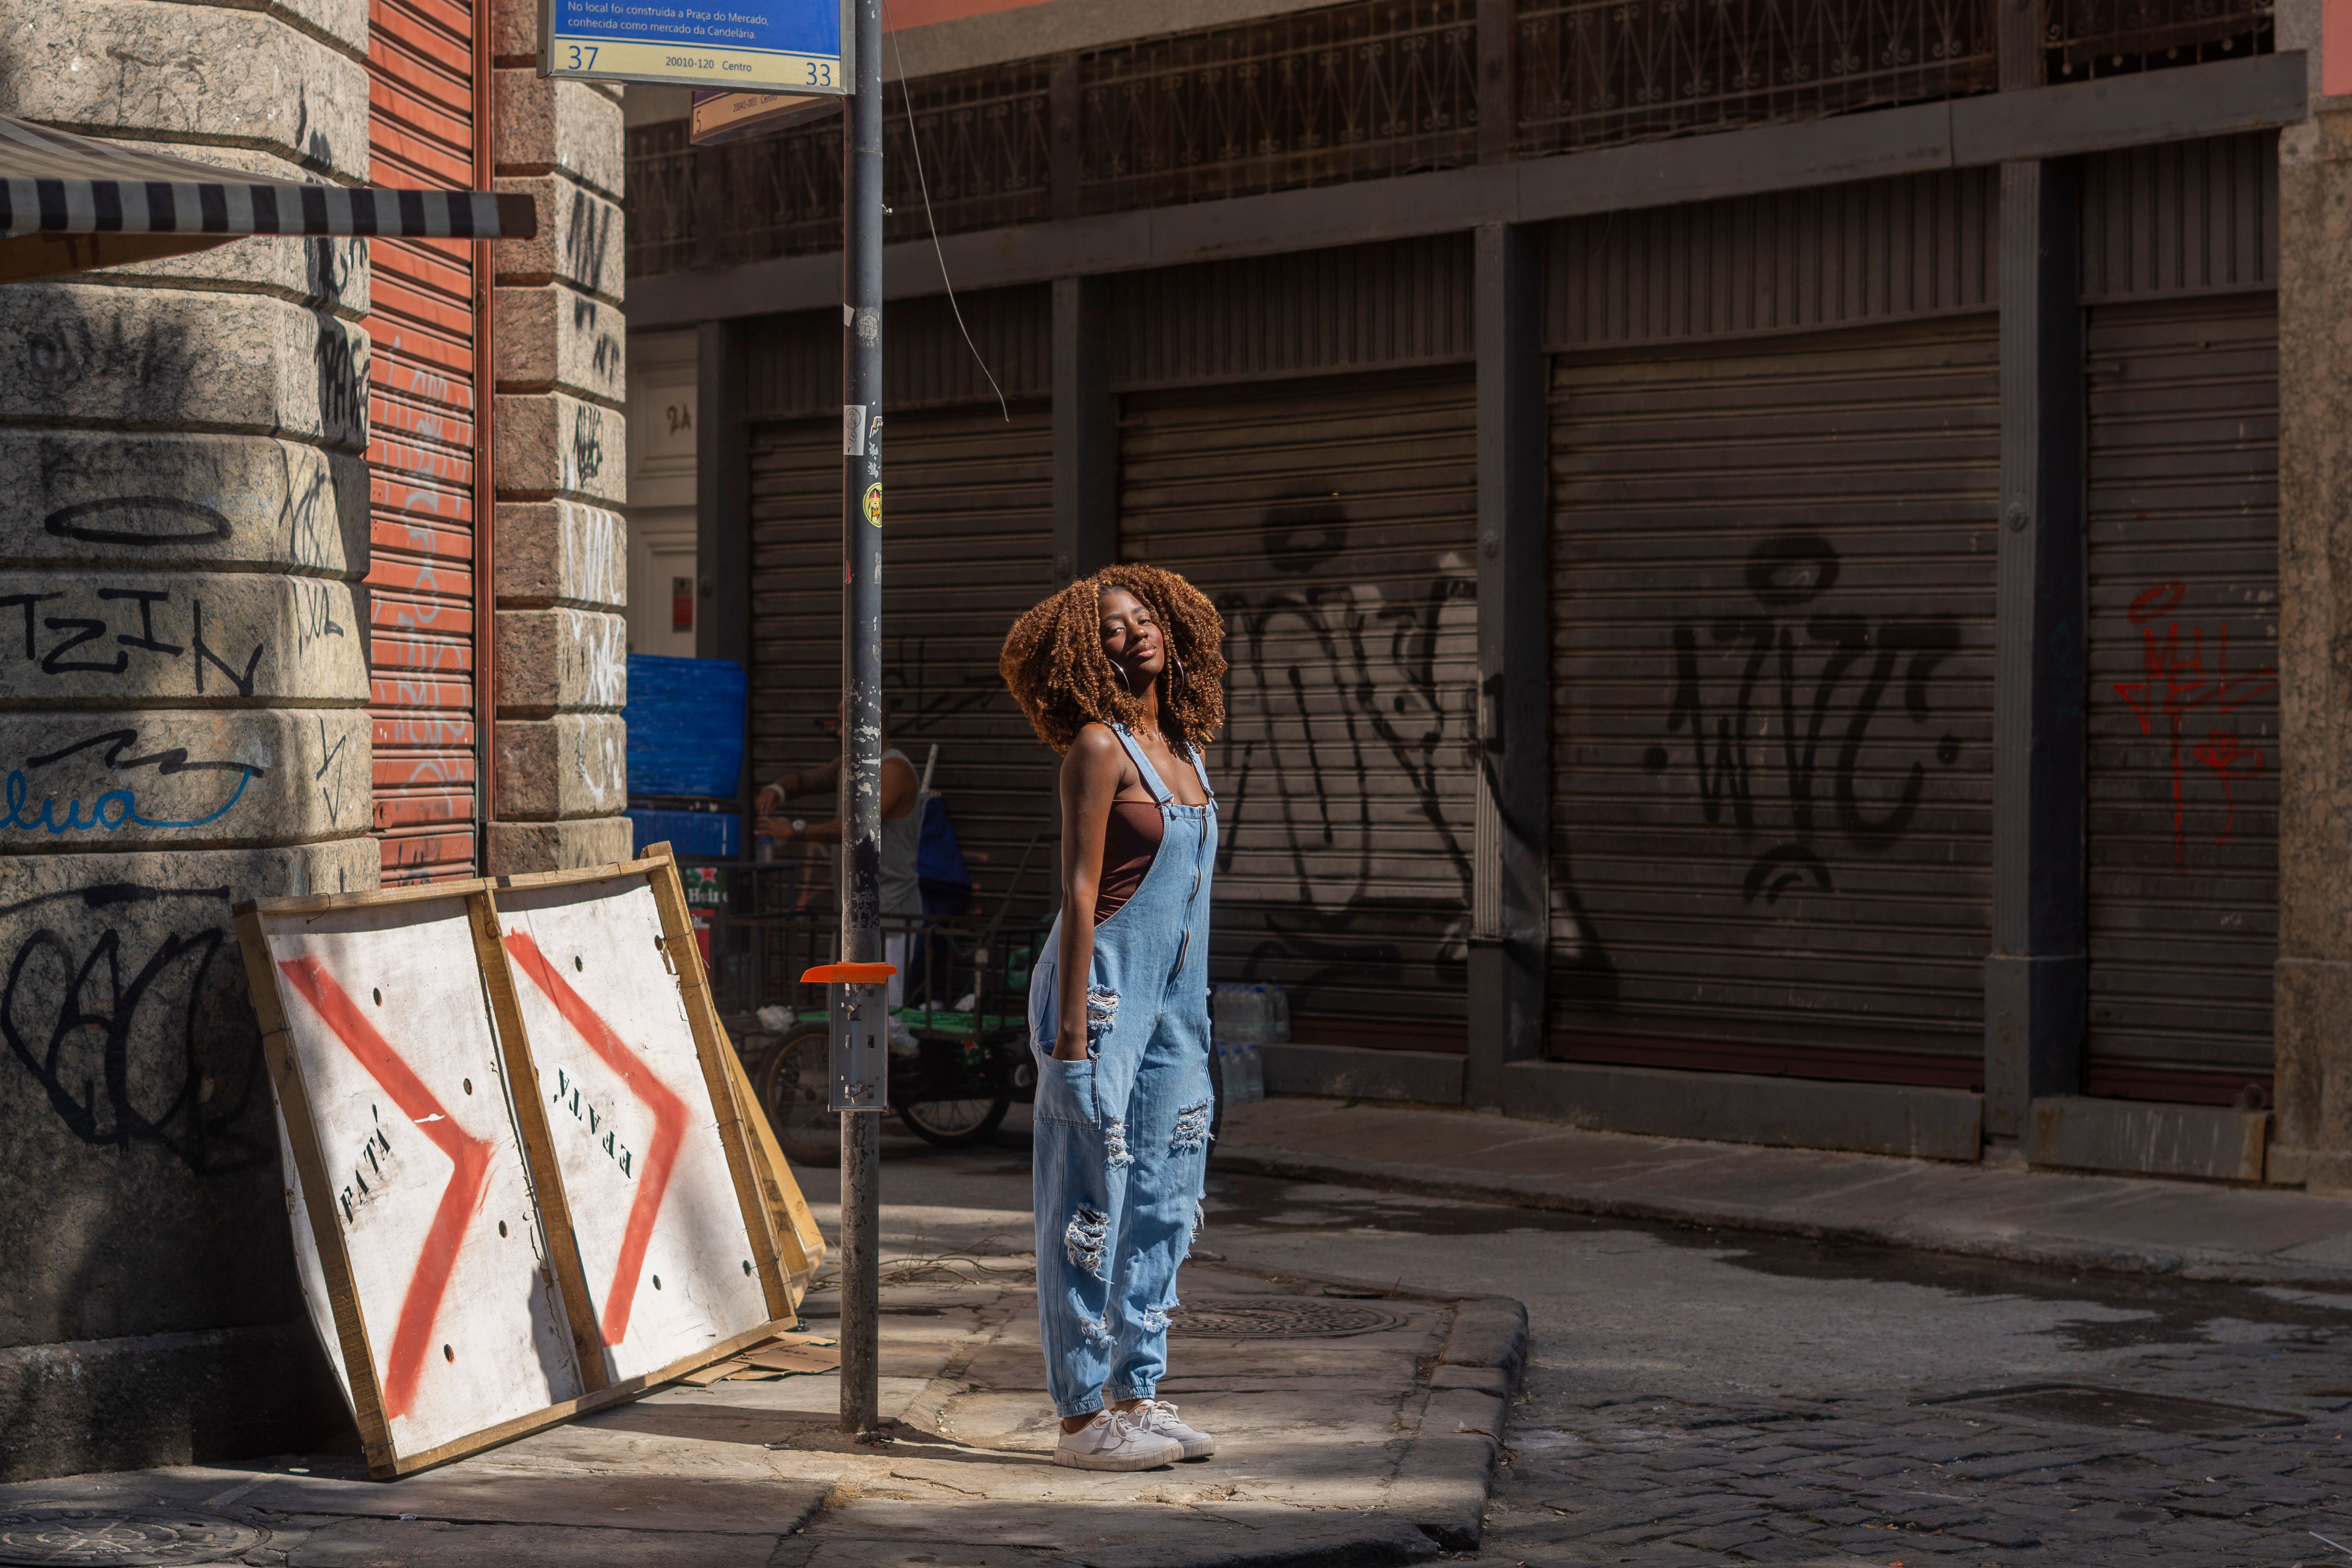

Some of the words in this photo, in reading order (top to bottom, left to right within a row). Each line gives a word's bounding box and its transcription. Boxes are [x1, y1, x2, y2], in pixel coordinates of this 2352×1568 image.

[568, 2, 583, 11] No
[586, 2, 608, 13] local
[611, 4, 623, 13] foi
[627, 7, 675, 17] construída
[686, 9, 711, 21] Praça
[714, 11, 726, 21] do
[729, 13, 769, 26] Mercado,
[568, 18, 618, 29] conhecida
[621, 22, 647, 31] como
[650, 24, 691, 33] mercado
[694, 25, 705, 34] da
[708, 26, 756, 39] Candelária.
[568, 45, 599, 70] 37
[666, 57, 714, 69] 20010-120
[722, 61, 752, 71] Centro
[806, 62, 831, 86] 33
[733, 98, 757, 112] 20041-003
[697, 111, 701, 133] 5
[554, 1067, 632, 1179] EFATÁ
